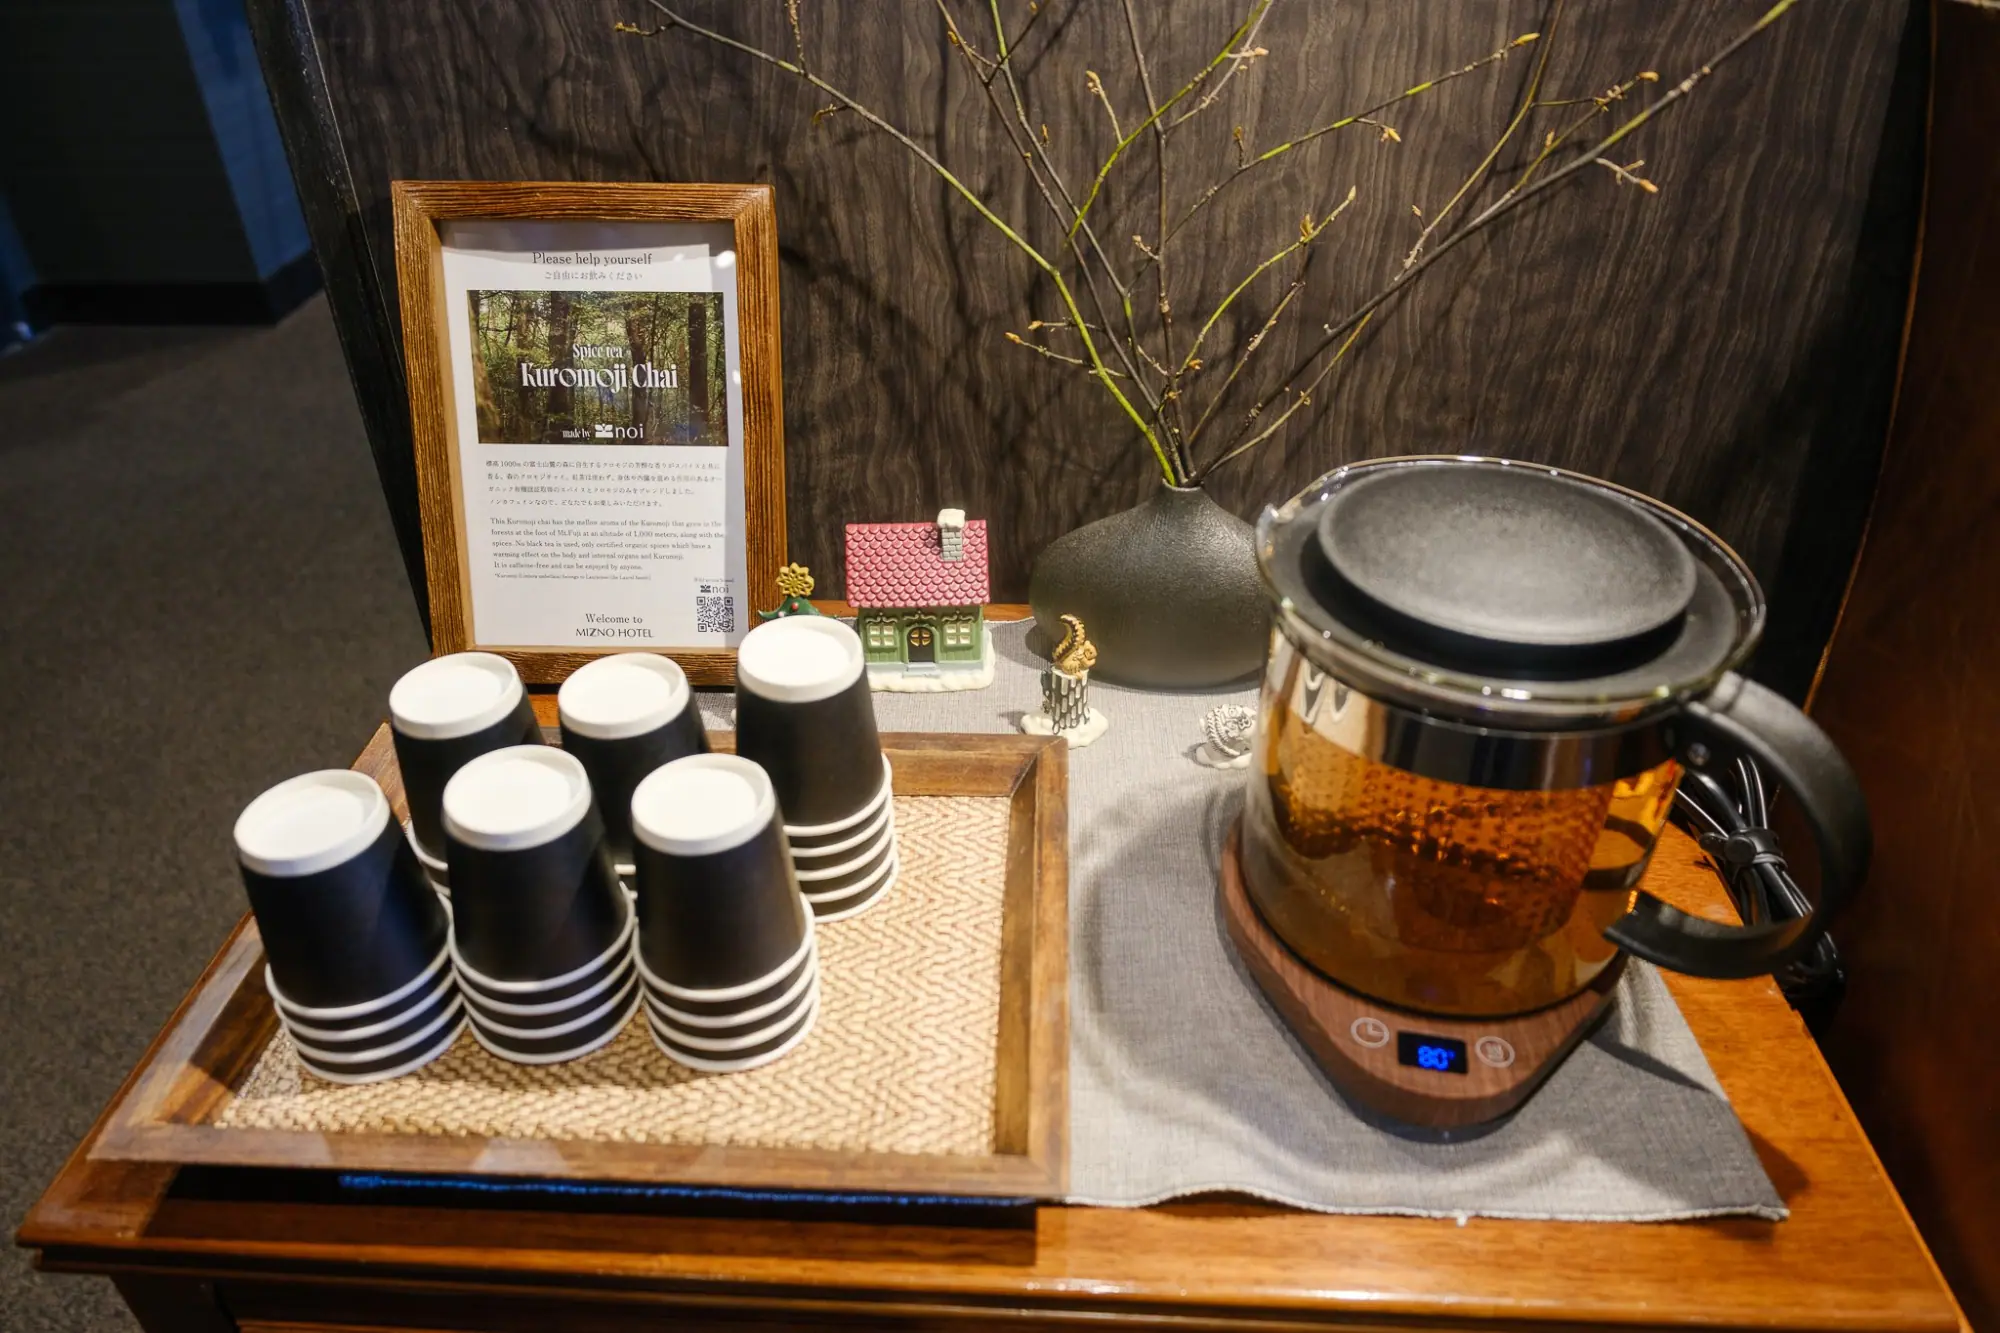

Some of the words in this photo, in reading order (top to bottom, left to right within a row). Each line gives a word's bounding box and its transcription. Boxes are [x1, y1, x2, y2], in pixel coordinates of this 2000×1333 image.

[532, 252, 572, 264] Please
[575, 252, 600, 266] help
[603, 253, 652, 266] yourself
[544, 270, 642, 280] ご自由にお飲みください
[573, 343, 601, 359] Spice
[606, 345, 623, 358] tea
[521, 362, 627, 393] Kuromoji
[632, 362, 678, 388] Chai
[562, 428, 582, 438] made
[582, 428, 591, 440] by
[615, 423, 644, 439] noi
[490, 517, 505, 525] This
[633, 530, 653, 538] 1,000
[654, 531, 679, 539] meters,
[698, 531, 713, 539] with
[527, 540, 543, 548] black
[563, 541, 580, 549] used,
[581, 541, 594, 550] only
[625, 542, 648, 550] organic
[493, 551, 520, 560] warming
[520, 551, 539, 559] effect
[562, 551, 577, 560] body
[617, 553, 639, 561] organs
[585, 562, 609, 570] enjoyed
[610, 562, 618, 571] by
[712, 585, 729, 594] noi
[585, 614, 630, 624] Welcome
[633, 614, 643, 624] to
[576, 628, 615, 638] MIZNO
[618, 628, 653, 639] HOTEL
